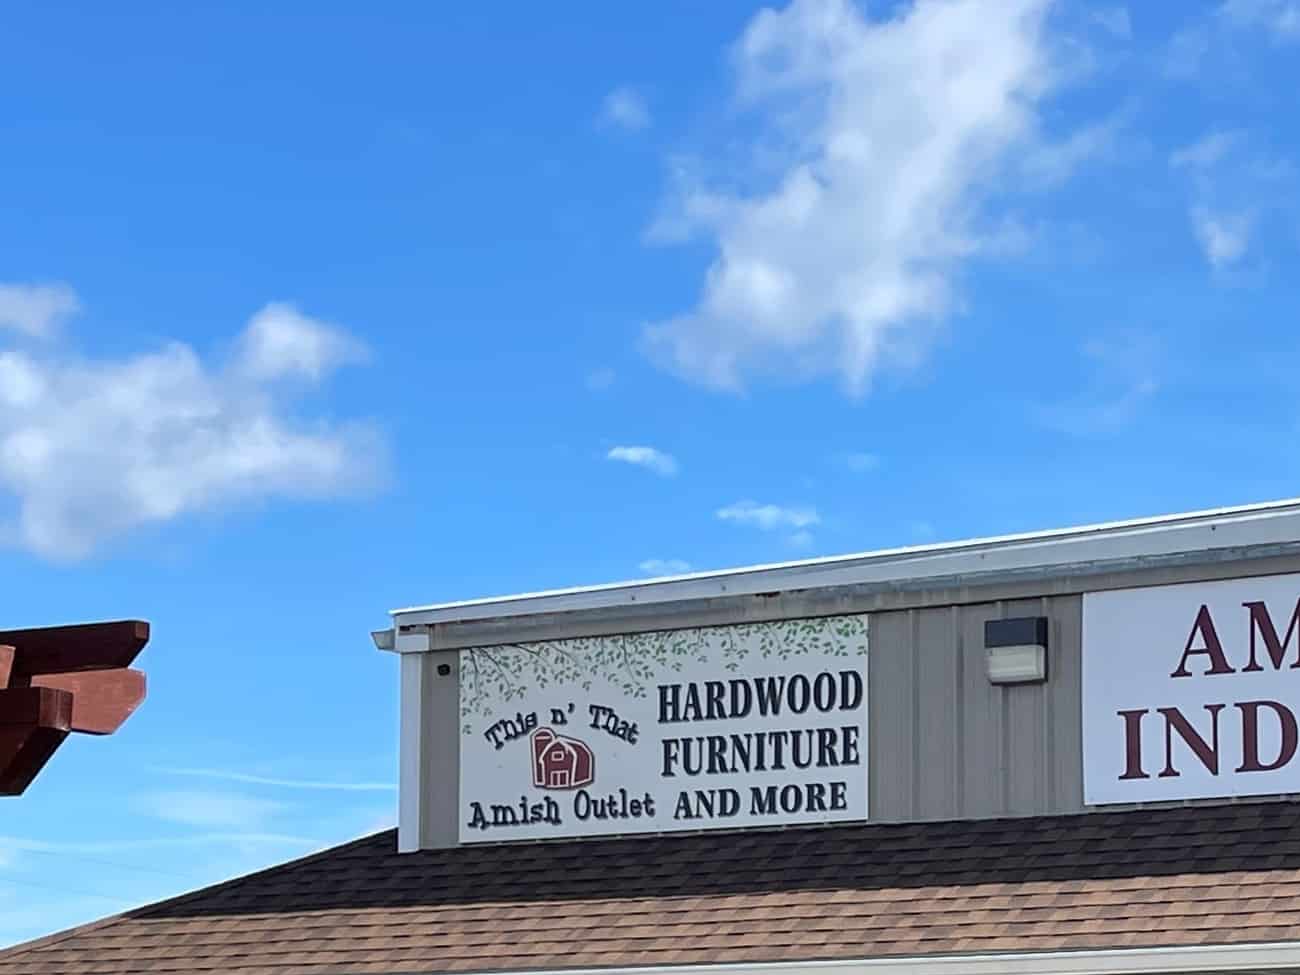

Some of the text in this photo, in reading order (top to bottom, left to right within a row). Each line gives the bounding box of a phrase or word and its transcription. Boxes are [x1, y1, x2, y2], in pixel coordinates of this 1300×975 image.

[657, 670, 863, 723] HARDWOOD
[484, 711, 538, 750] This
[589, 704, 640, 745] That
[661, 726, 860, 777] FURNITURE
[468, 788, 656, 830] Amish Outlet
[674, 782, 847, 819] AND MORE
